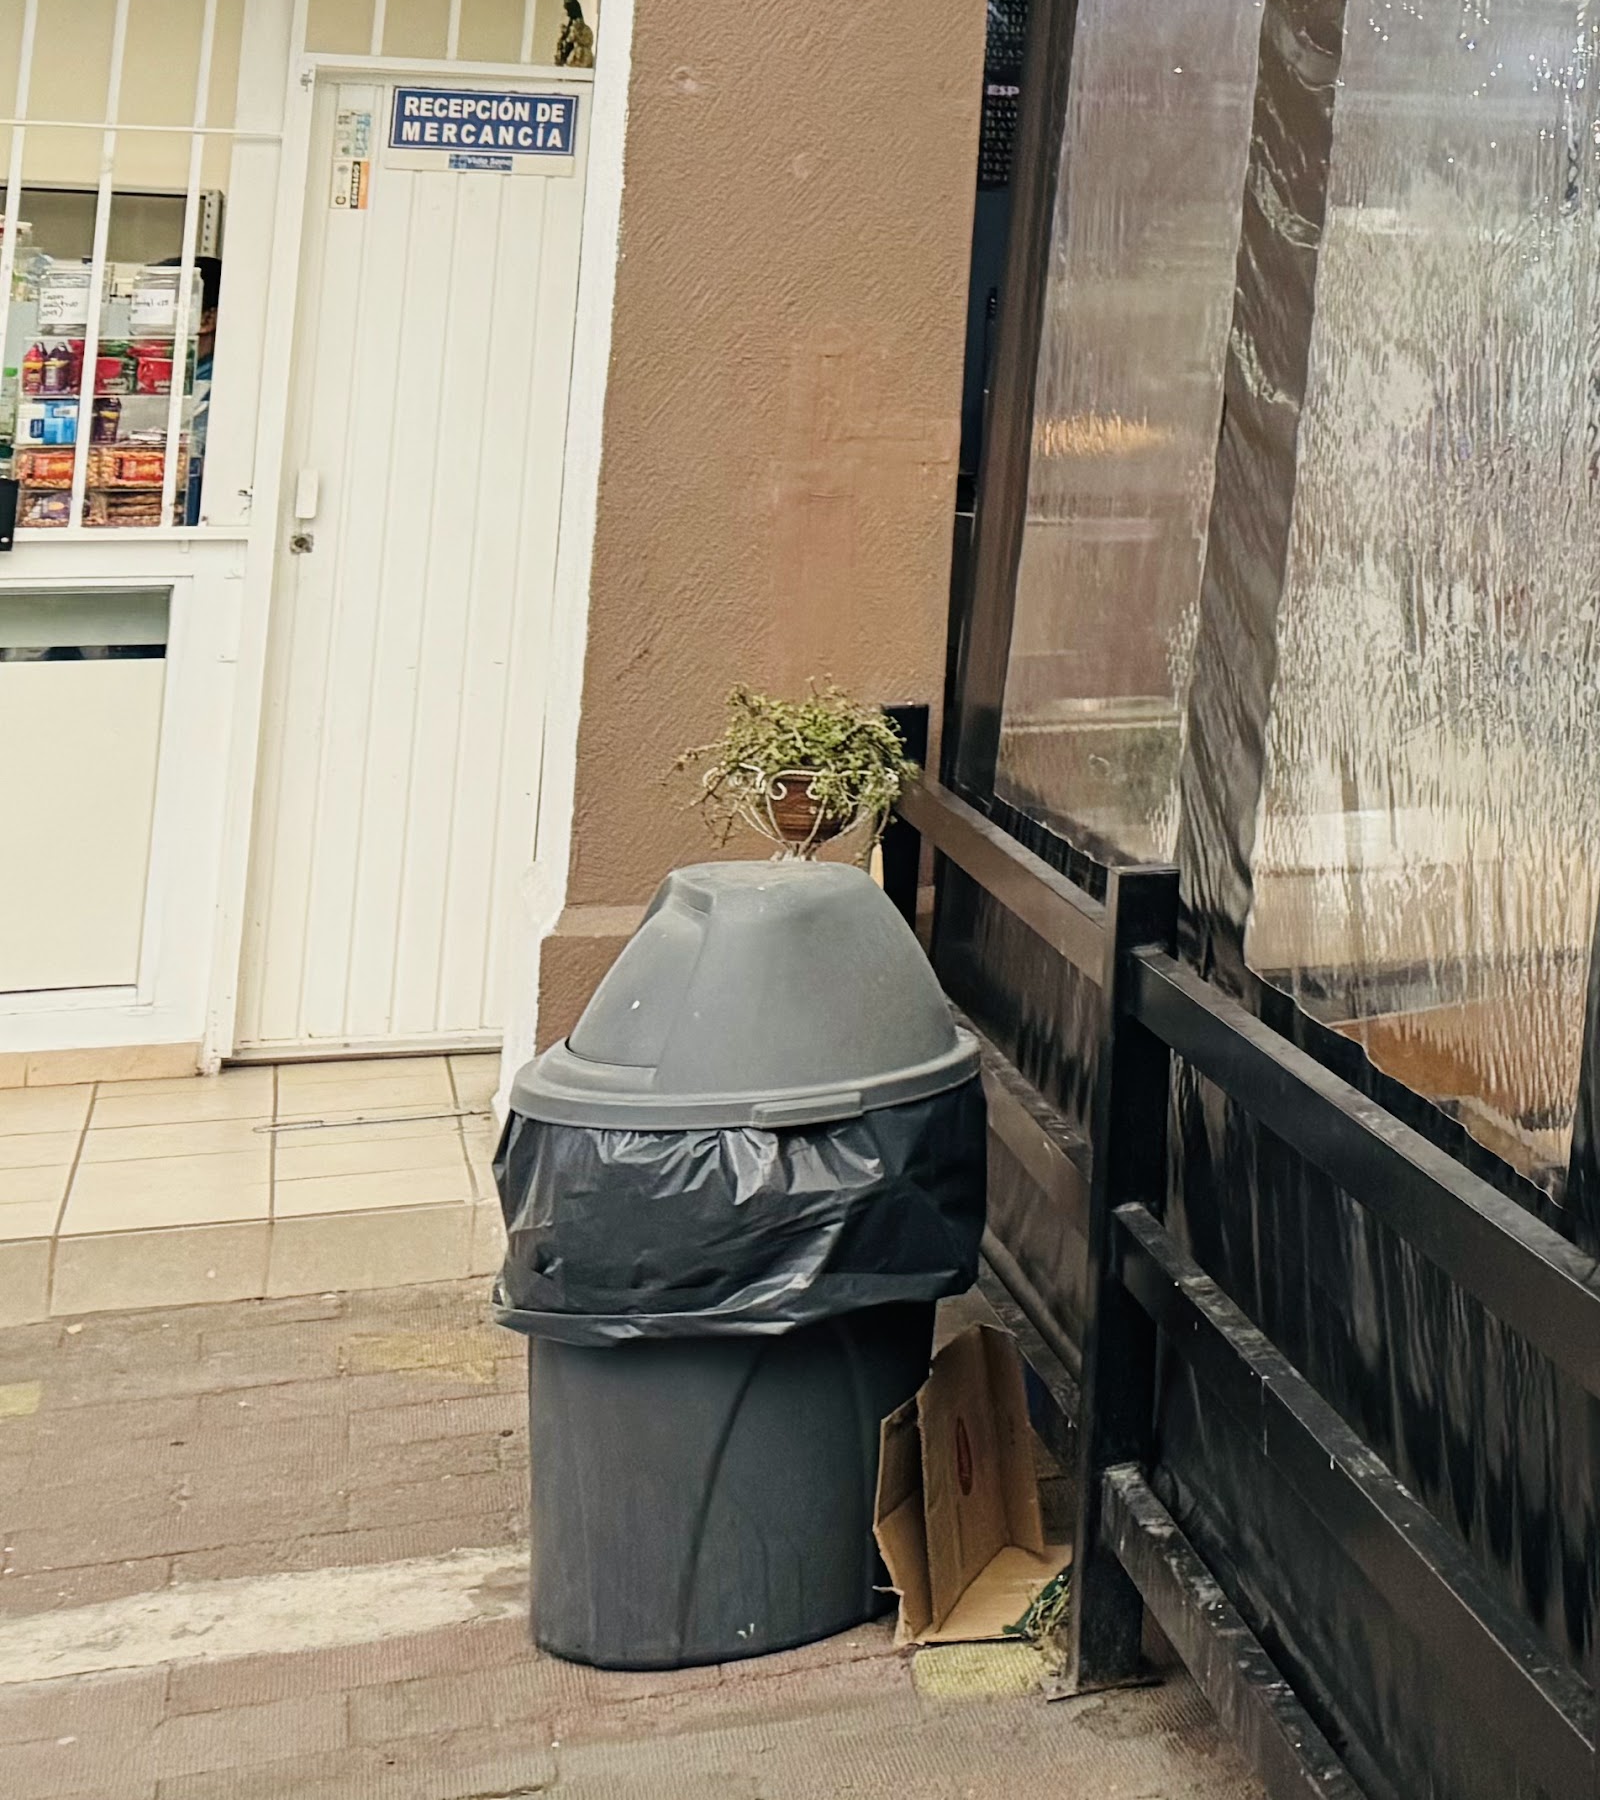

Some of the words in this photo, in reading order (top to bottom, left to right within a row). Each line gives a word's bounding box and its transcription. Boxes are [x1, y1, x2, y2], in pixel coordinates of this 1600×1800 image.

[404, 96, 530, 122] RECEPCIÓN
[536, 102, 565, 123] DE
[401, 120, 563, 148] MERCANCÍA
